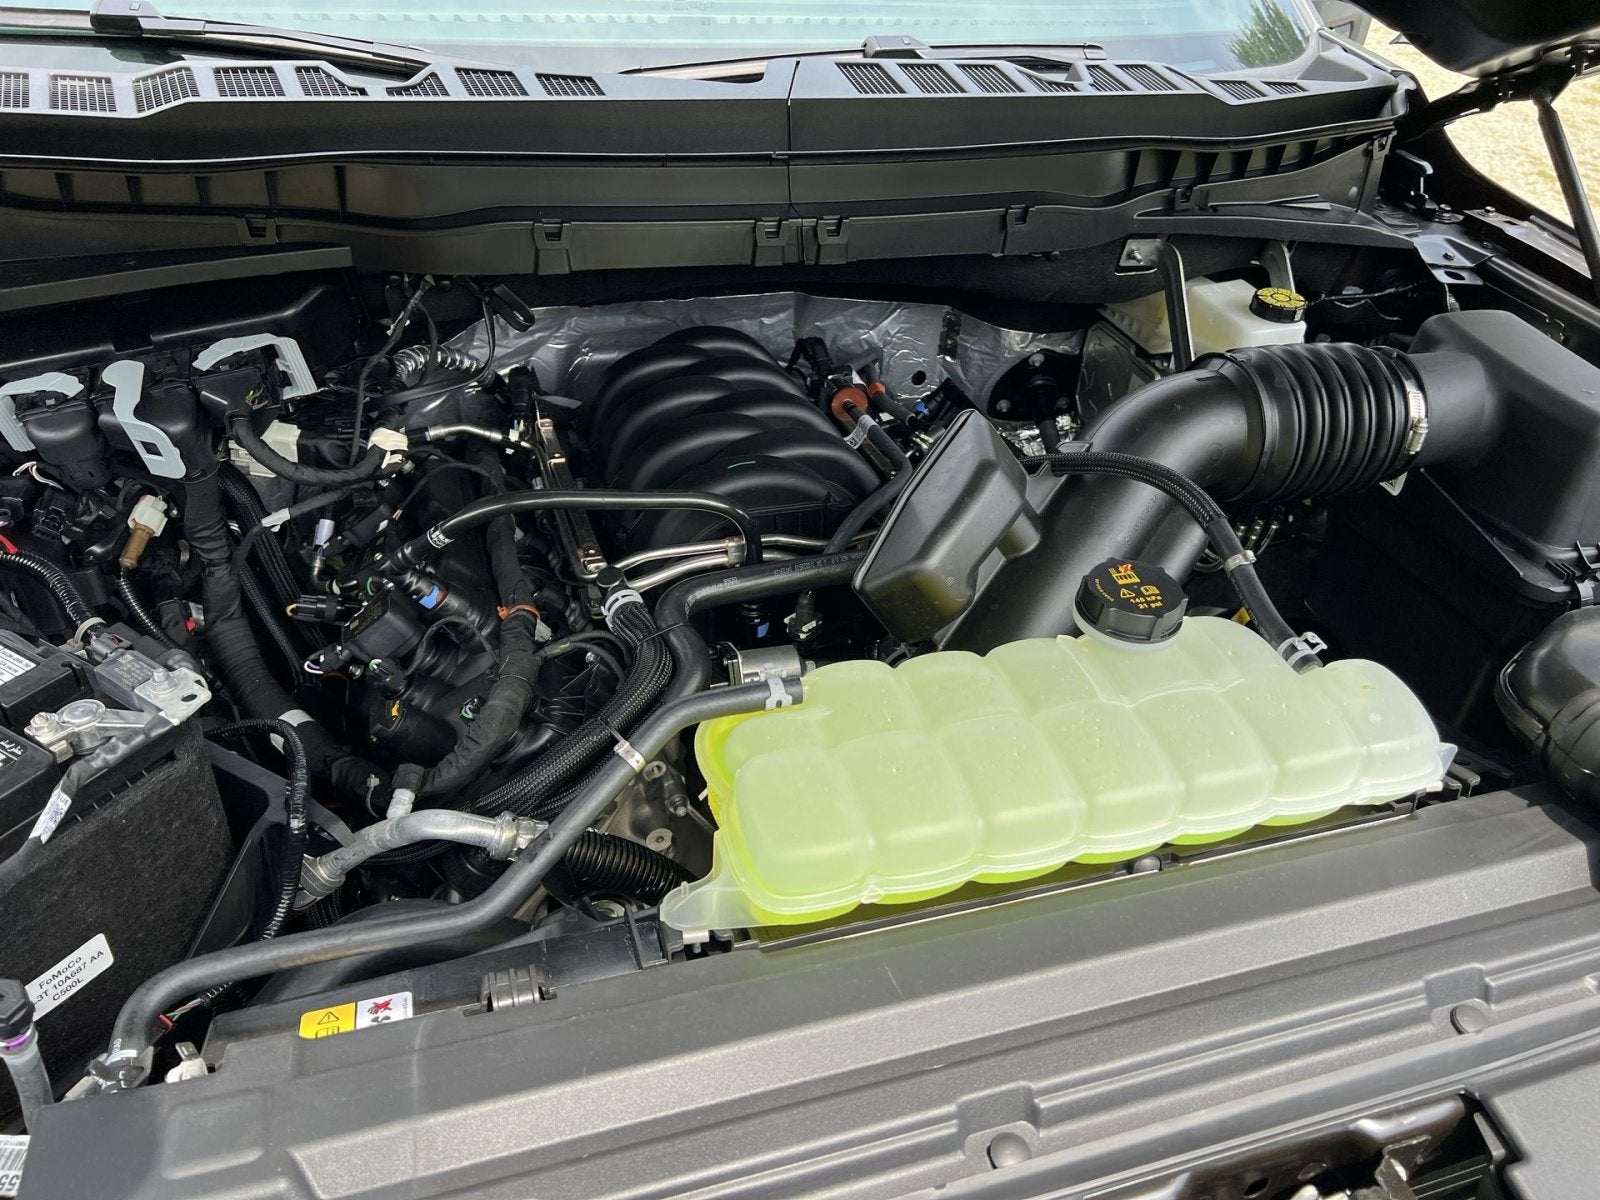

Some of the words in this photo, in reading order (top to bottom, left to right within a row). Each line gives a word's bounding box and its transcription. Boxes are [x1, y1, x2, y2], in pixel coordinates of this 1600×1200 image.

[33, 990, 50, 1005] 3T
[52, 962, 87, 991] 10A687
[89, 950, 105, 963] AA
[38, 956, 82, 990] FoMoCo
[52, 977, 85, 1002] C500L
